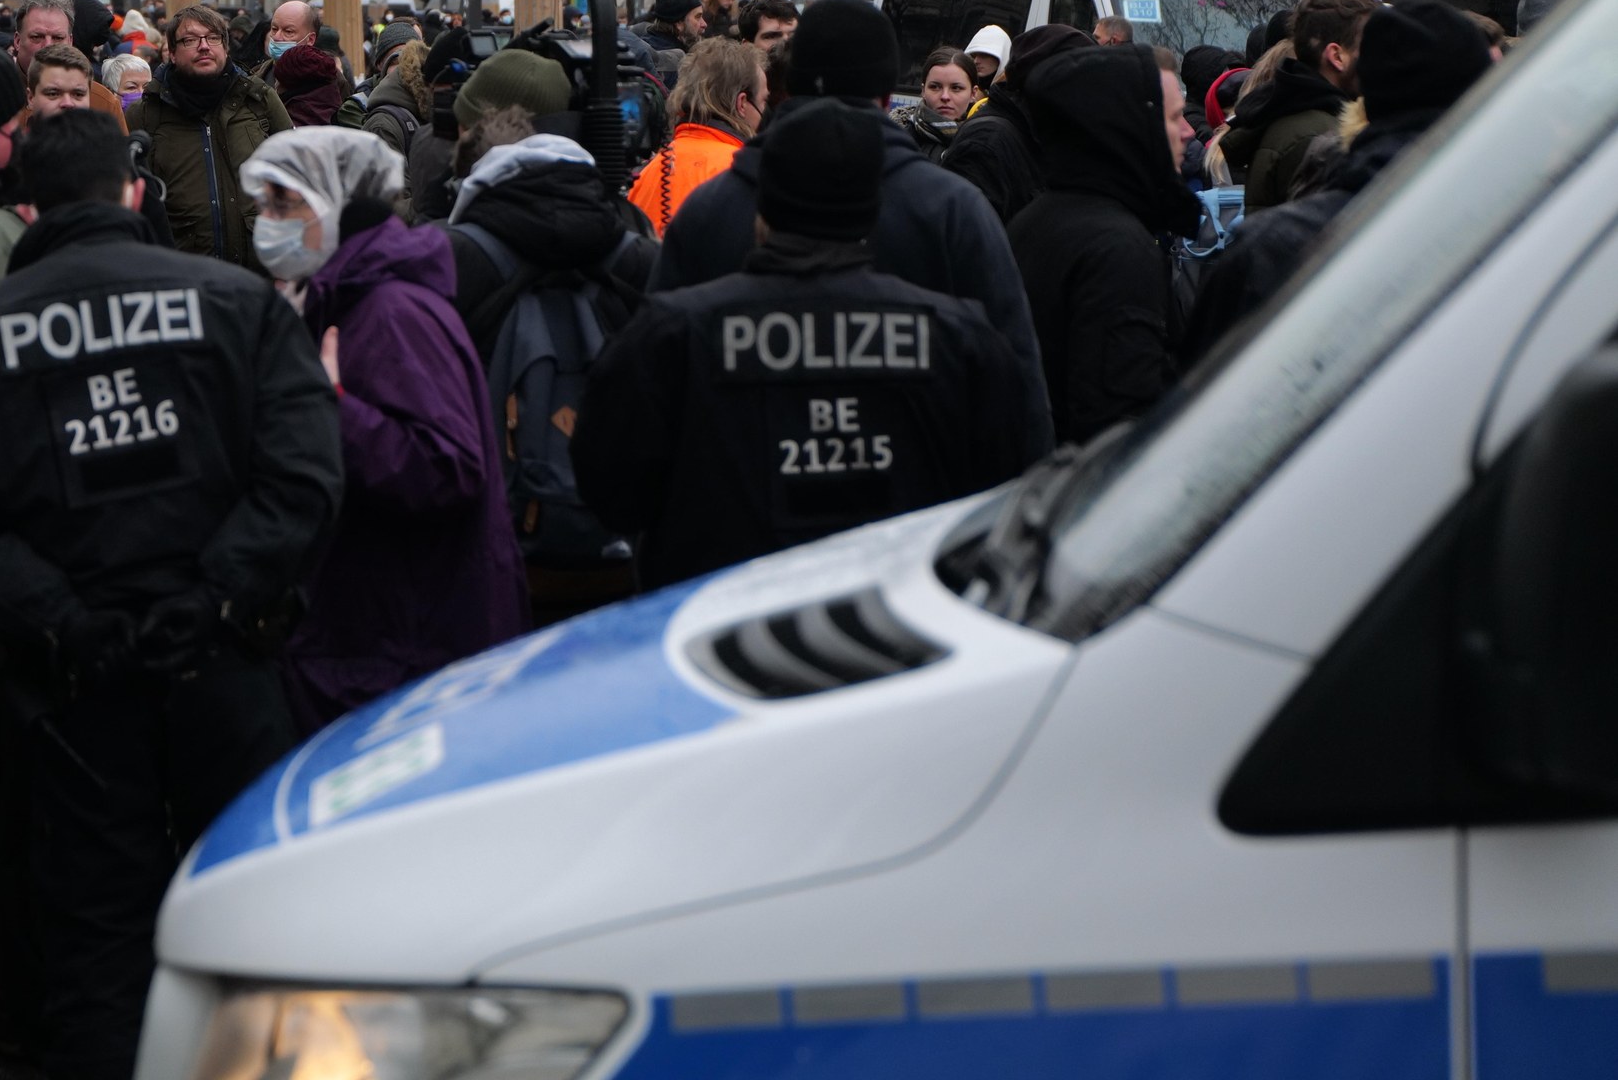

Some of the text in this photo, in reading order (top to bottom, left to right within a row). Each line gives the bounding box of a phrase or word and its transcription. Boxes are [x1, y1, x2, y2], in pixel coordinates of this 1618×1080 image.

[723, 311, 931, 371] POLIZEI
[88, 368, 144, 412] BE
[65, 399, 179, 455] 21216
[809, 397, 860, 433] BE
[779, 435, 893, 474] 21215
